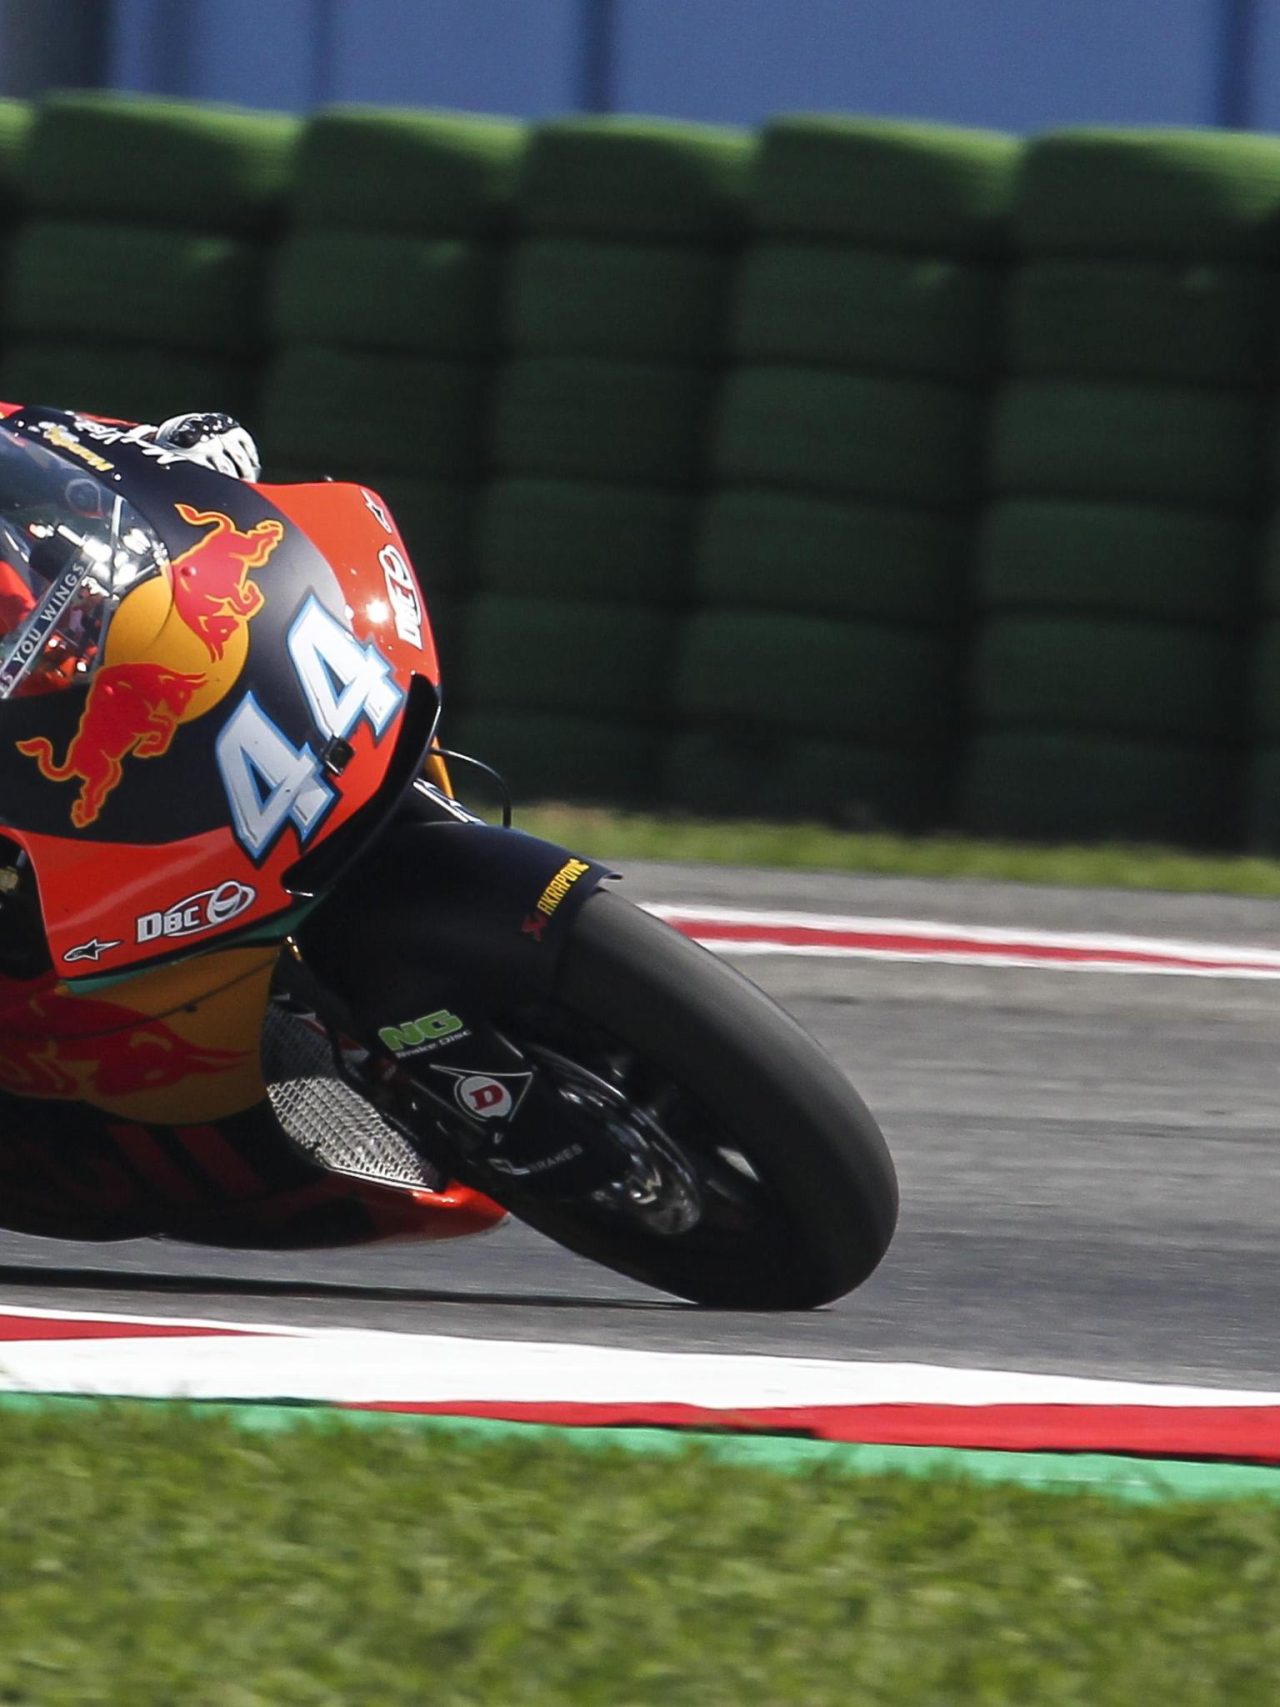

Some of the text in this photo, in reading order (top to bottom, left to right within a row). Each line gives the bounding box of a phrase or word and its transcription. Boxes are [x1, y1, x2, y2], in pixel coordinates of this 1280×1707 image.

[12, 628, 42, 666] YOU
[40, 562, 84, 622] WINGS
[214, 592, 407, 870] 44
[137, 906, 199, 943] DBC
[378, 1009, 463, 1052] NG
